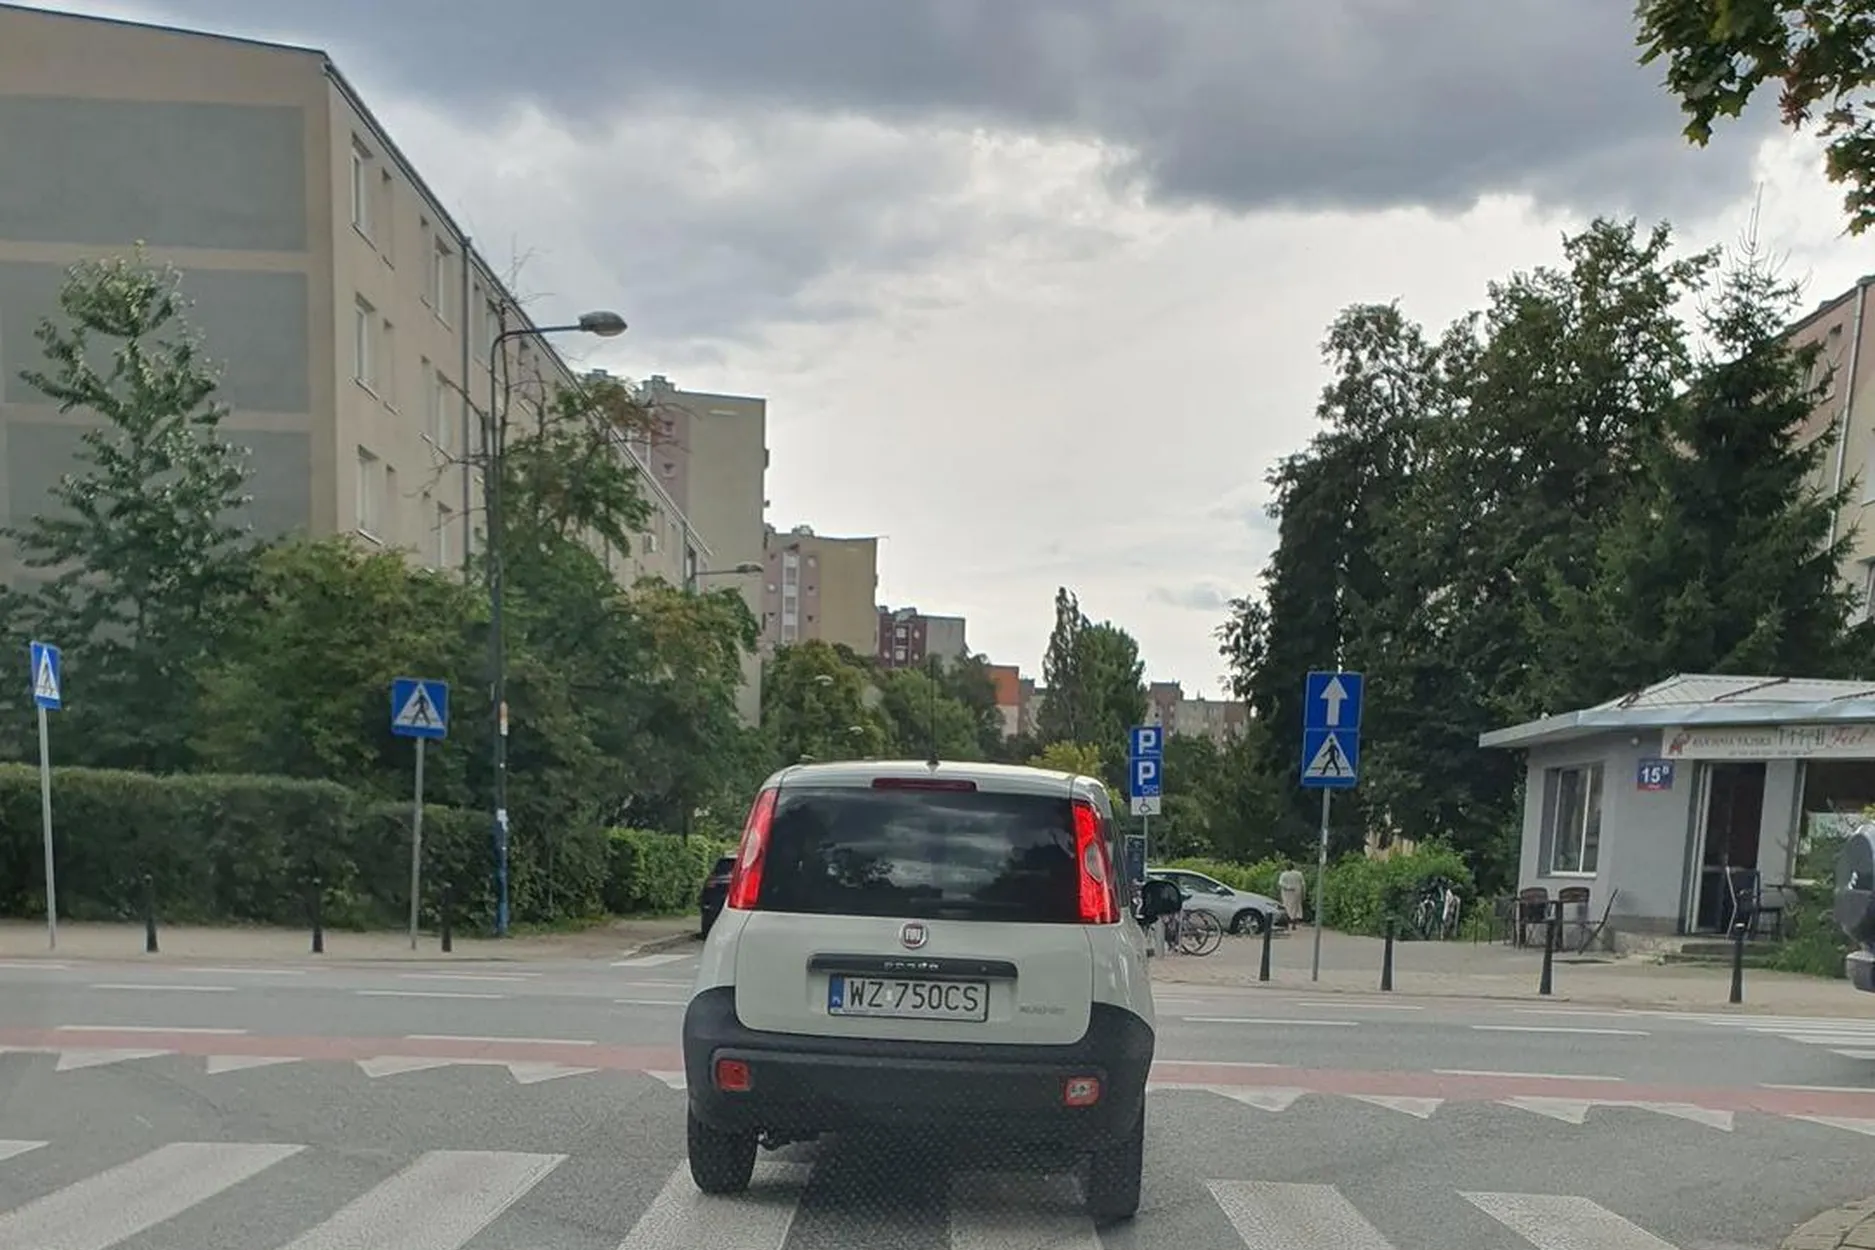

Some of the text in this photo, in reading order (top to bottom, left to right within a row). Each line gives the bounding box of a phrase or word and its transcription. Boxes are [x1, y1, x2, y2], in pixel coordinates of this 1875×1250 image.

[1138, 729, 1157, 755] P
[1137, 761, 1156, 786] P
[849, 980, 979, 1012] WZ 750CS
